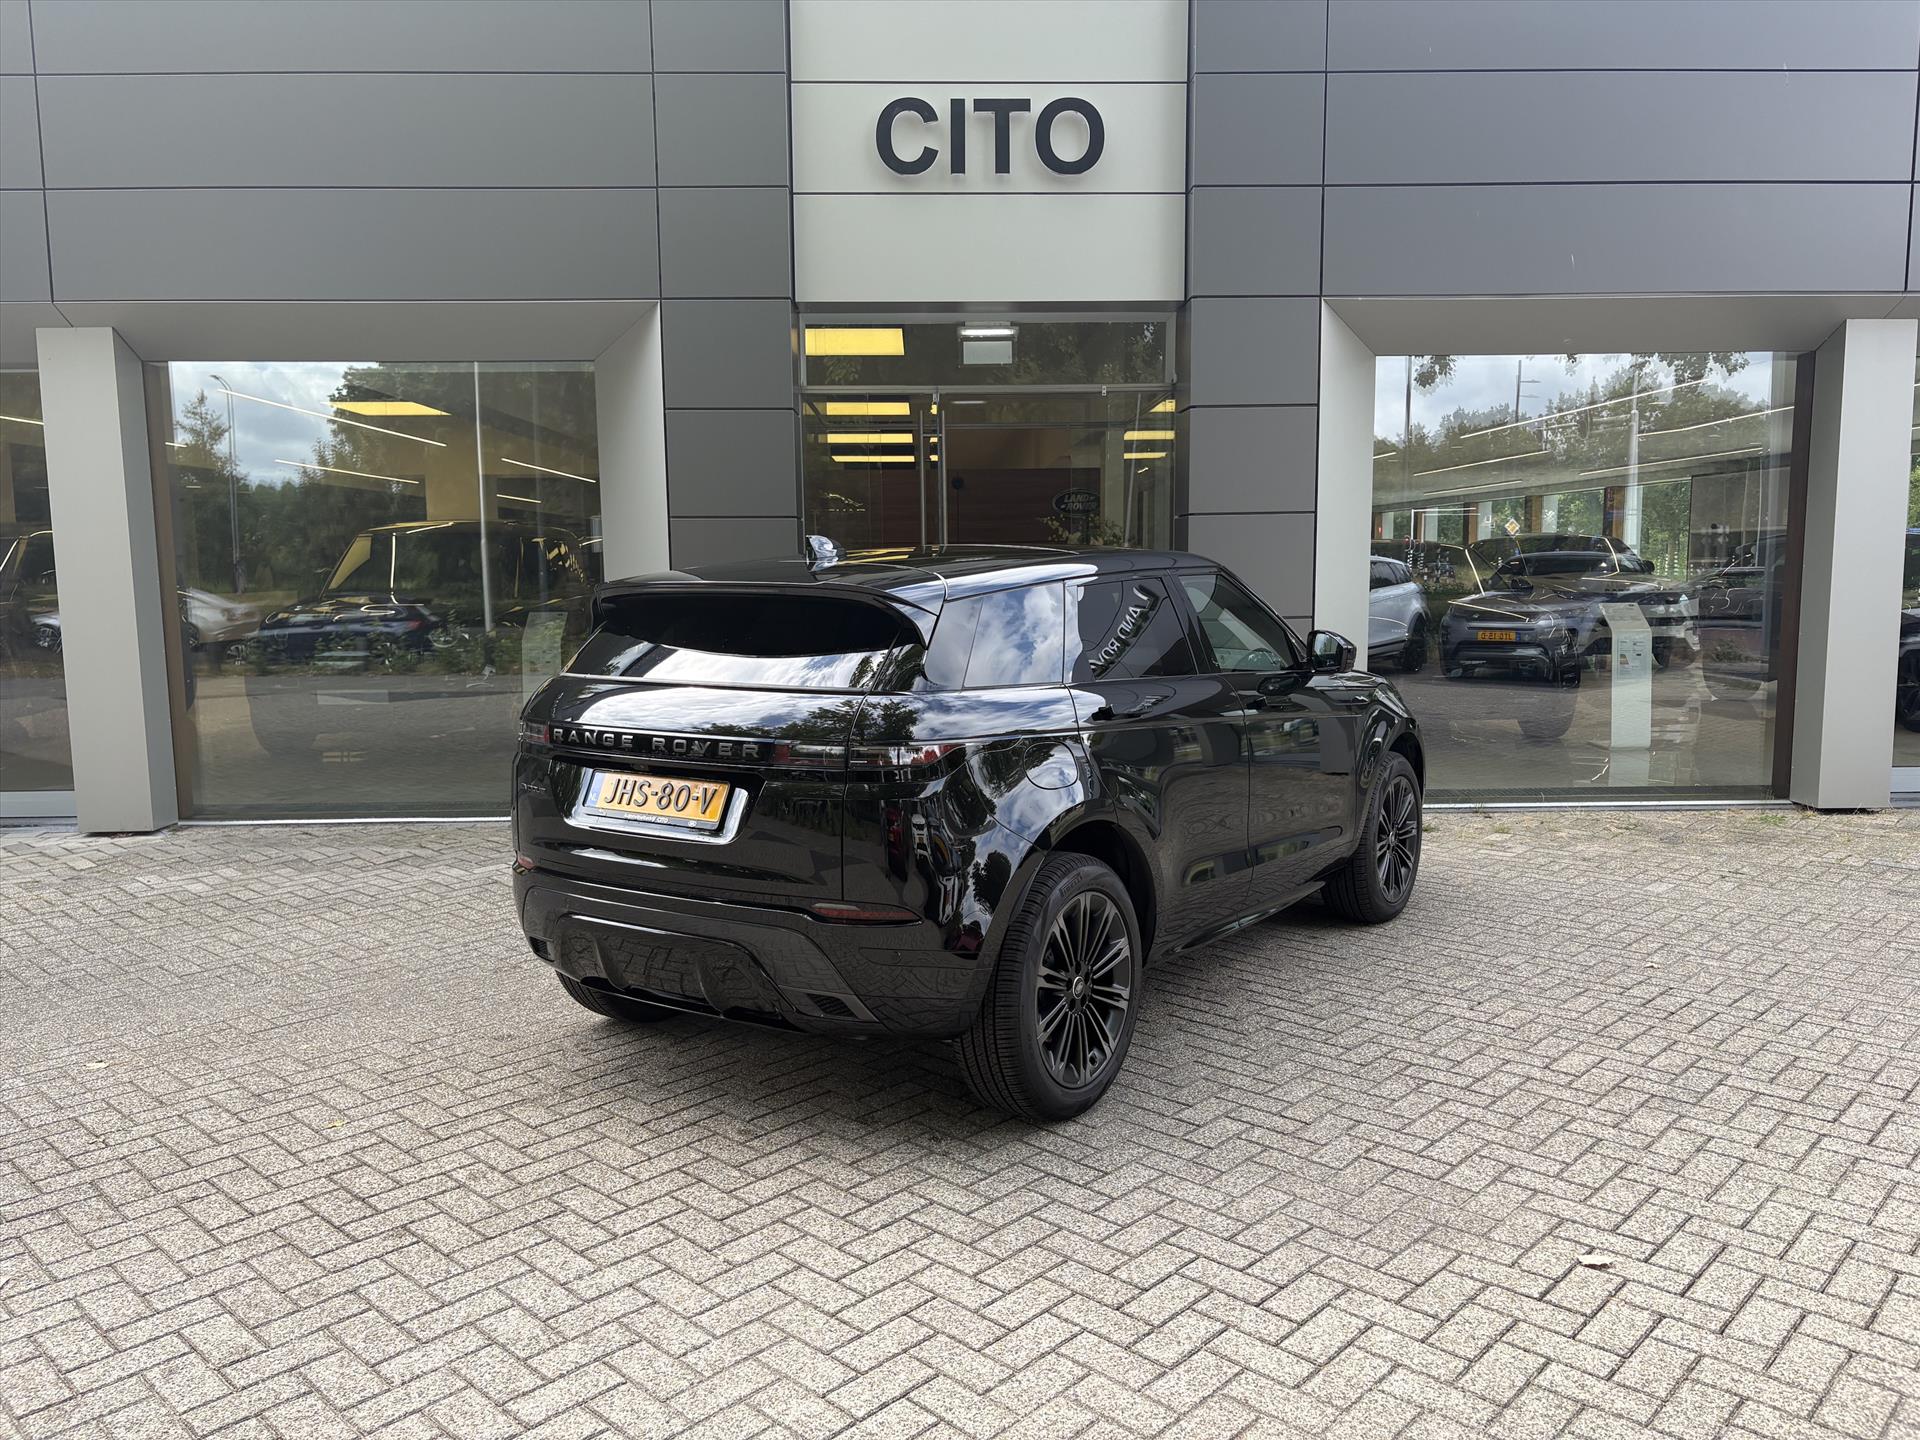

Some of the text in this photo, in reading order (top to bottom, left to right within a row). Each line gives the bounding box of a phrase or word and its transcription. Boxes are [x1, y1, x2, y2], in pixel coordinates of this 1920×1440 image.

[876, 97, 1105, 175] CITO
[1064, 494, 1090, 502] LAND
[1066, 502, 1098, 511] ROVER
[553, 728, 759, 758] RANGE ROVER
[604, 778, 717, 814] JHS-80-V
